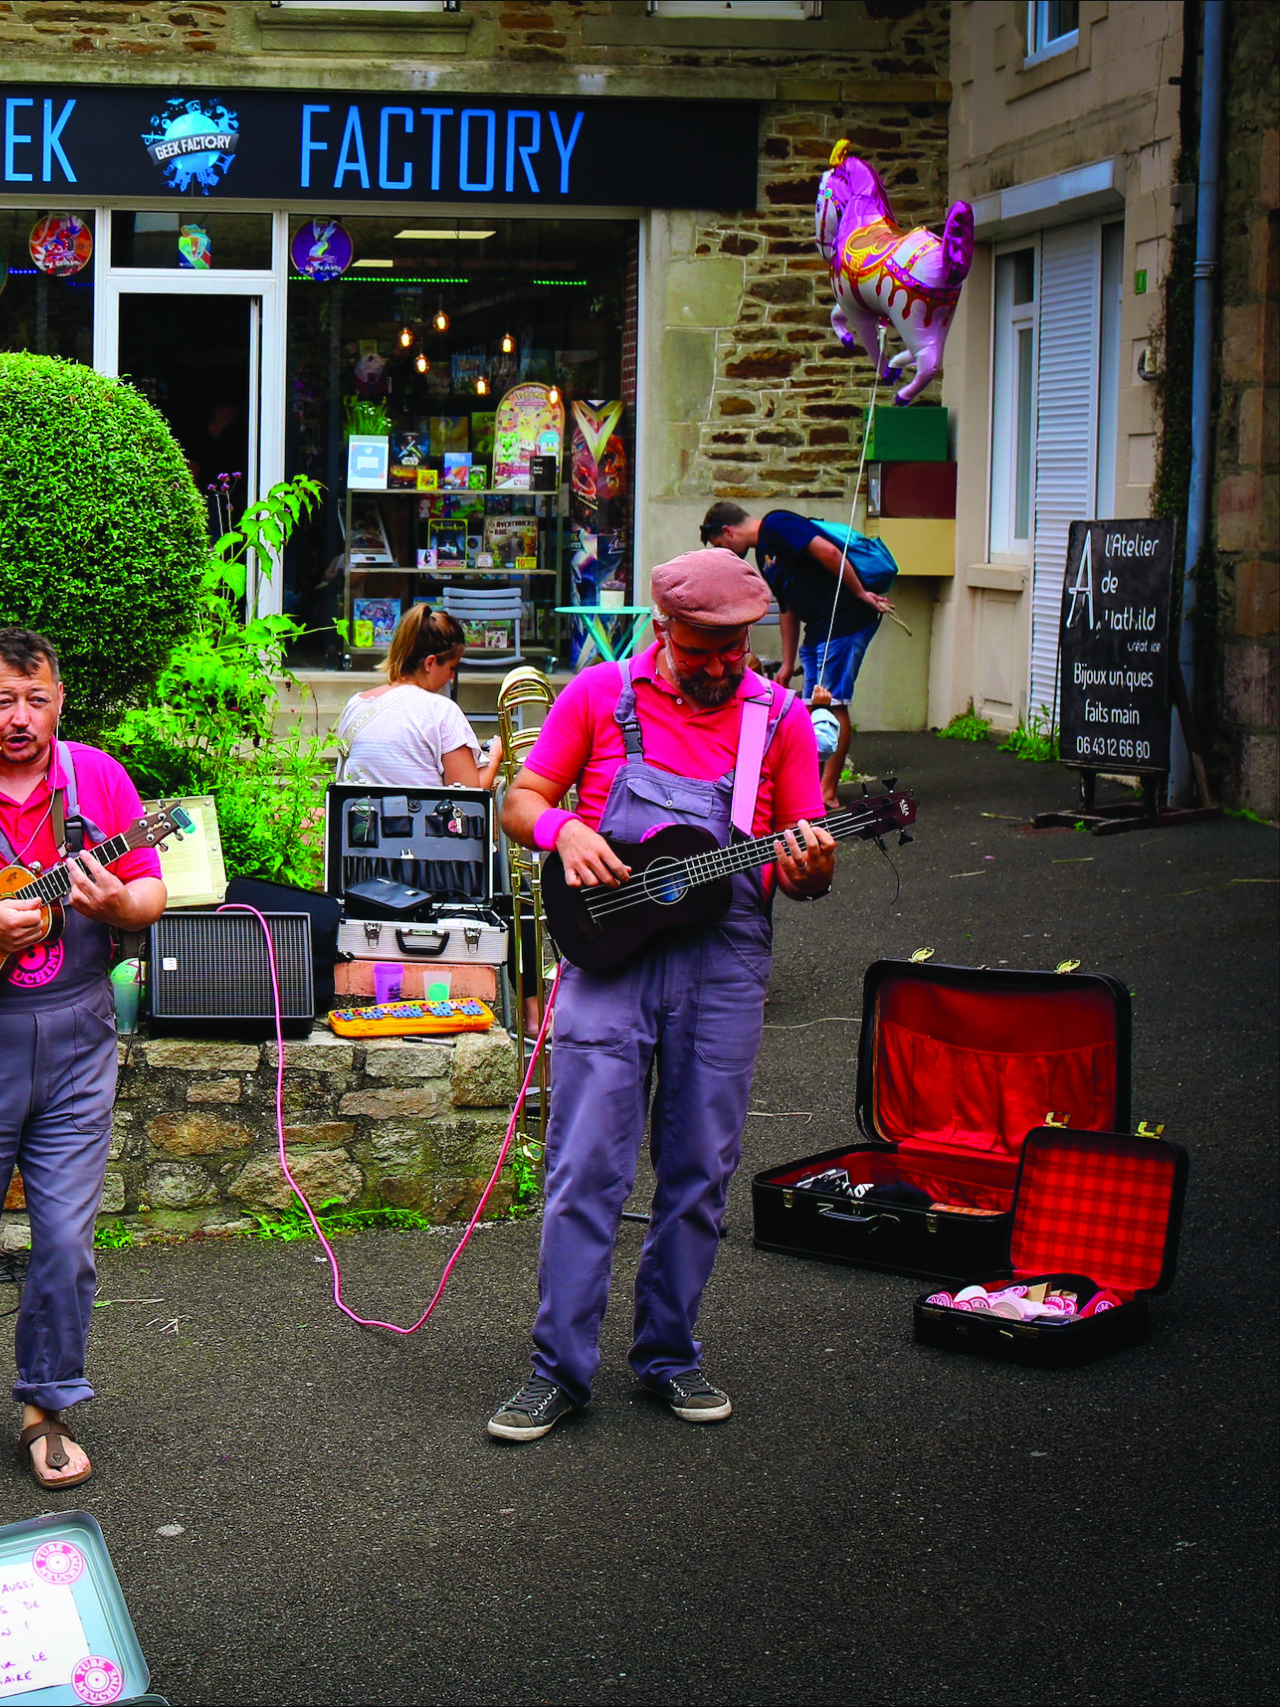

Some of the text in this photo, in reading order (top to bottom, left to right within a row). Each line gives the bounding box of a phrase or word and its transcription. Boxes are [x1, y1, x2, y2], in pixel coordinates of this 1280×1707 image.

[155, 135, 232, 161] GEEK FACTORY
[301, 104, 585, 195] FACTORY
[1105, 533, 1159, 558] l'Atelier
[1101, 570, 1119, 594] de
[1074, 662, 1107, 690] Bijoux
[1085, 700, 1140, 725] faits main
[1076, 735, 1150, 760] 06 43 12 66 80
[12, 945, 59, 984] UCHINE
[22, 1600, 41, 1610] DE
[32, 1651, 48, 1663] LE
[76, 1658, 107, 1675] TUBE
